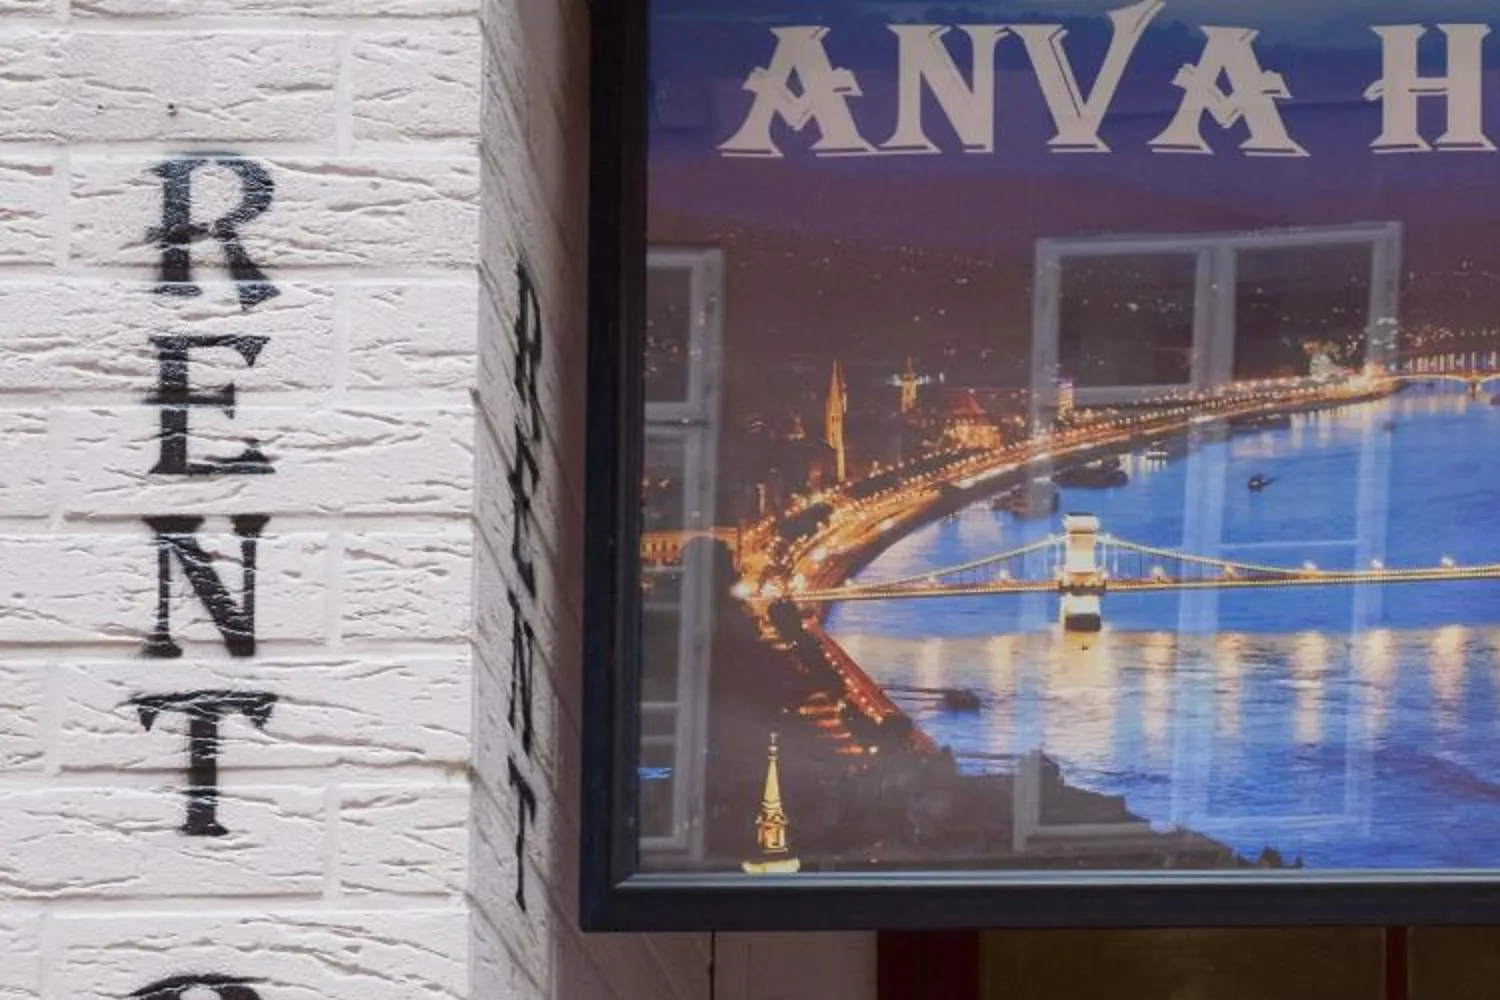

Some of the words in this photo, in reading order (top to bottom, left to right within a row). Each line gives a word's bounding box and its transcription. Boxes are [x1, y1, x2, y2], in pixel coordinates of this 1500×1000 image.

[716, 0, 1310, 157] ANVA
[126, 152, 281, 837] RENT
[507, 260, 543, 912] RENT
